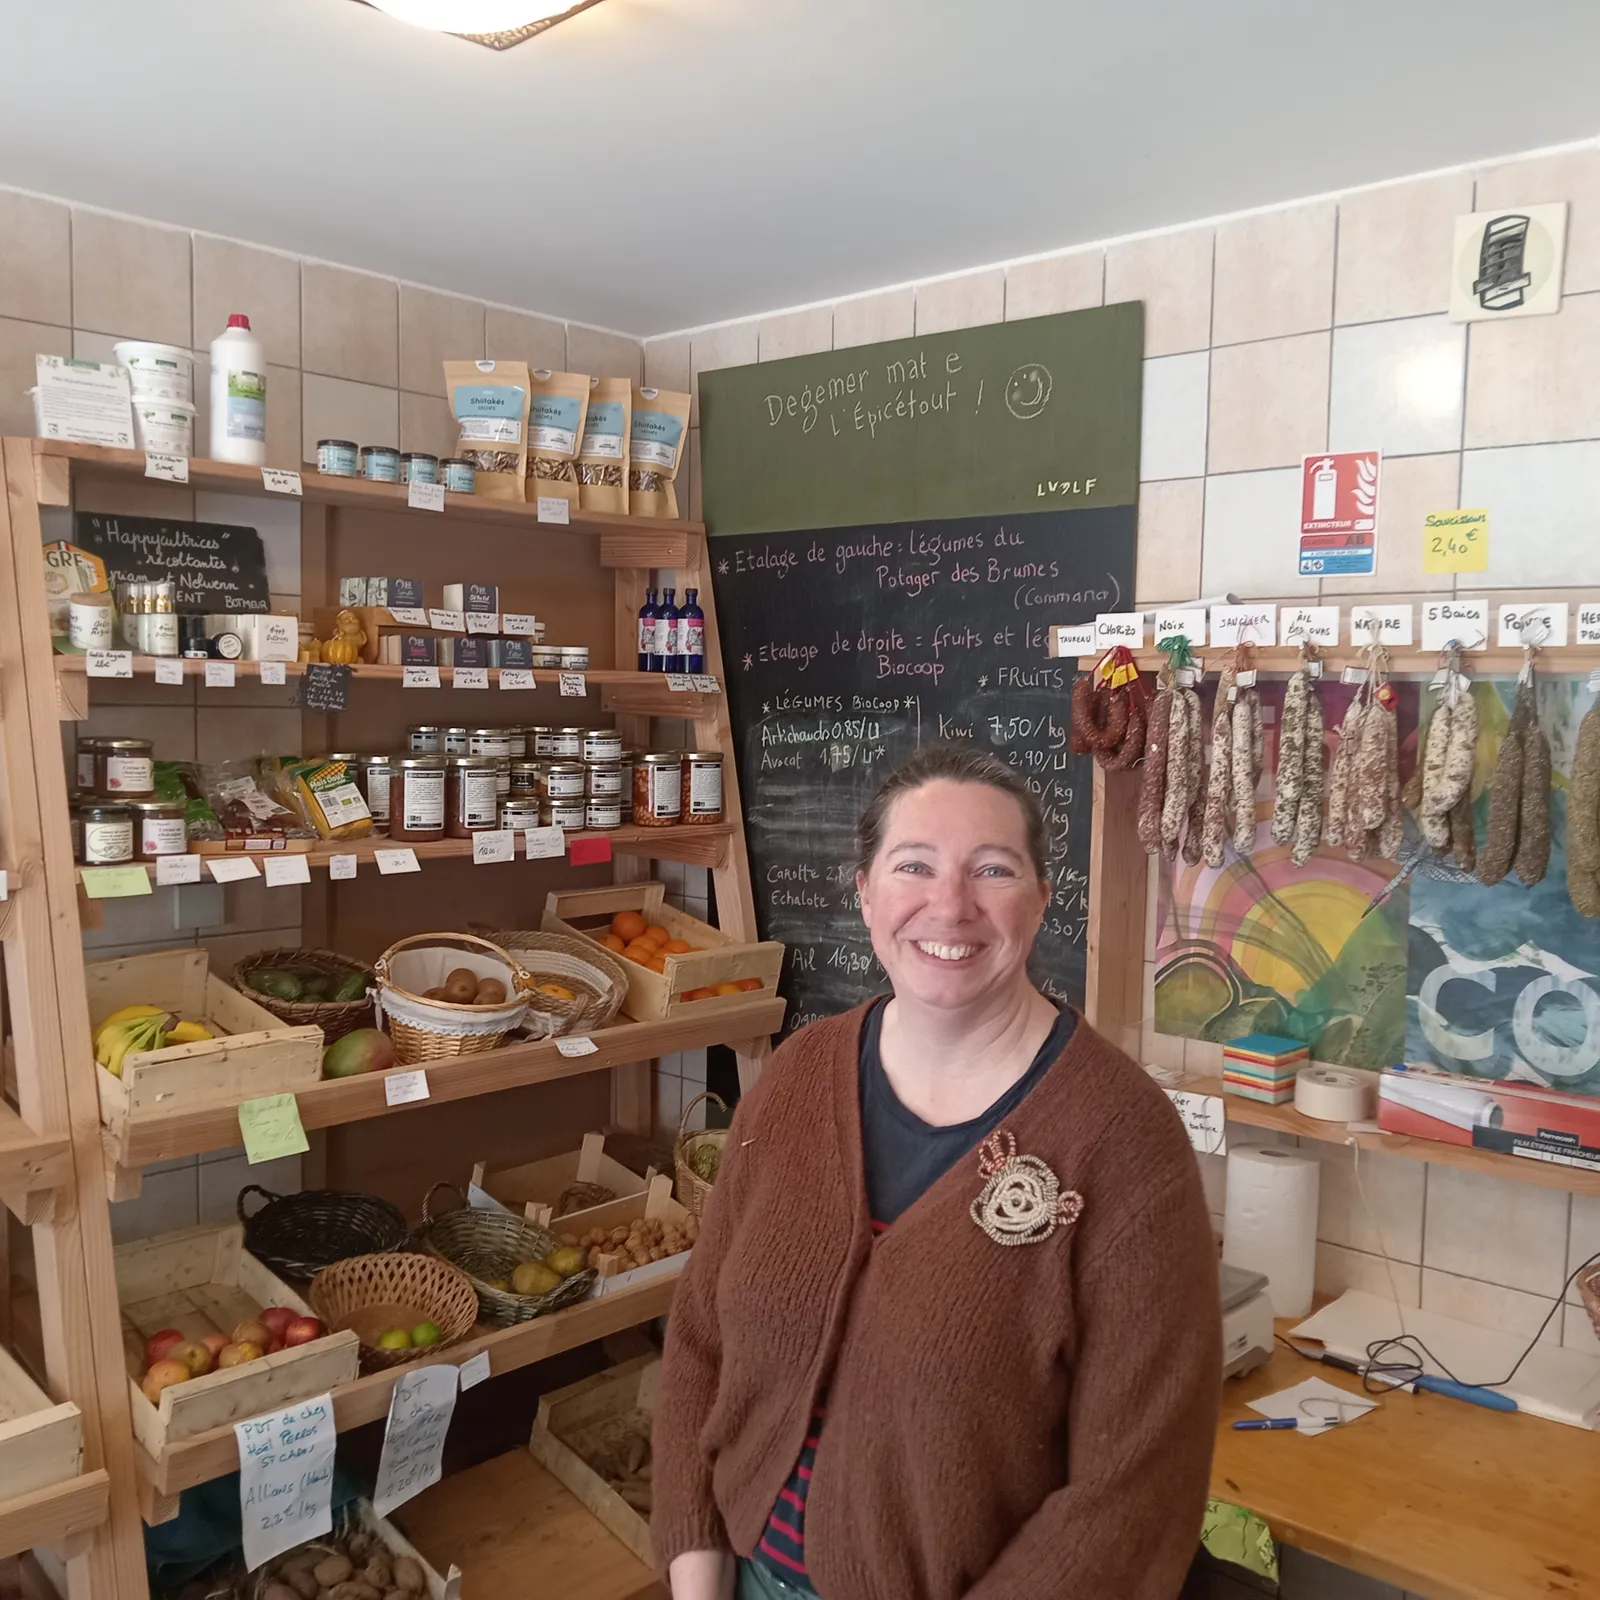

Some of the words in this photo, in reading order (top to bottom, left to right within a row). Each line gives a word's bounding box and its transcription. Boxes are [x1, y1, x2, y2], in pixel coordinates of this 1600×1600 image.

[764, 367, 868, 433] Degemer
[887, 352, 928, 386] mat
[1303, 520, 1352, 530] EXTINCTEUR
[735, 549, 800, 579] Etalage
[807, 537, 826, 563] de
[909, 531, 984, 566] légumes
[994, 530, 1025, 549] du
[876, 565, 941, 597] Potager
[950, 563, 980, 583] des
[987, 562, 1060, 584] Brumes
[225, 595, 269, 611] BOTMEUR
[1428, 607, 1438, 620] 5
[1441, 605, 1480, 619] Baies
[758, 644, 820, 672] Etalage
[831, 630, 851, 653] de
[856, 625, 907, 652] droite
[932, 625, 984, 661] fruits
[993, 623, 1016, 647] et
[1059, 634, 1092, 645] TAUREAU
[876, 656, 945, 686] Biocoop
[938, 713, 976, 740] Kiwi
[760, 749, 803, 771] Avocat
[771, 890, 830, 909] Echalote
[791, 947, 818, 972] Ail
[1513, 1138, 1531, 1149] FILM
